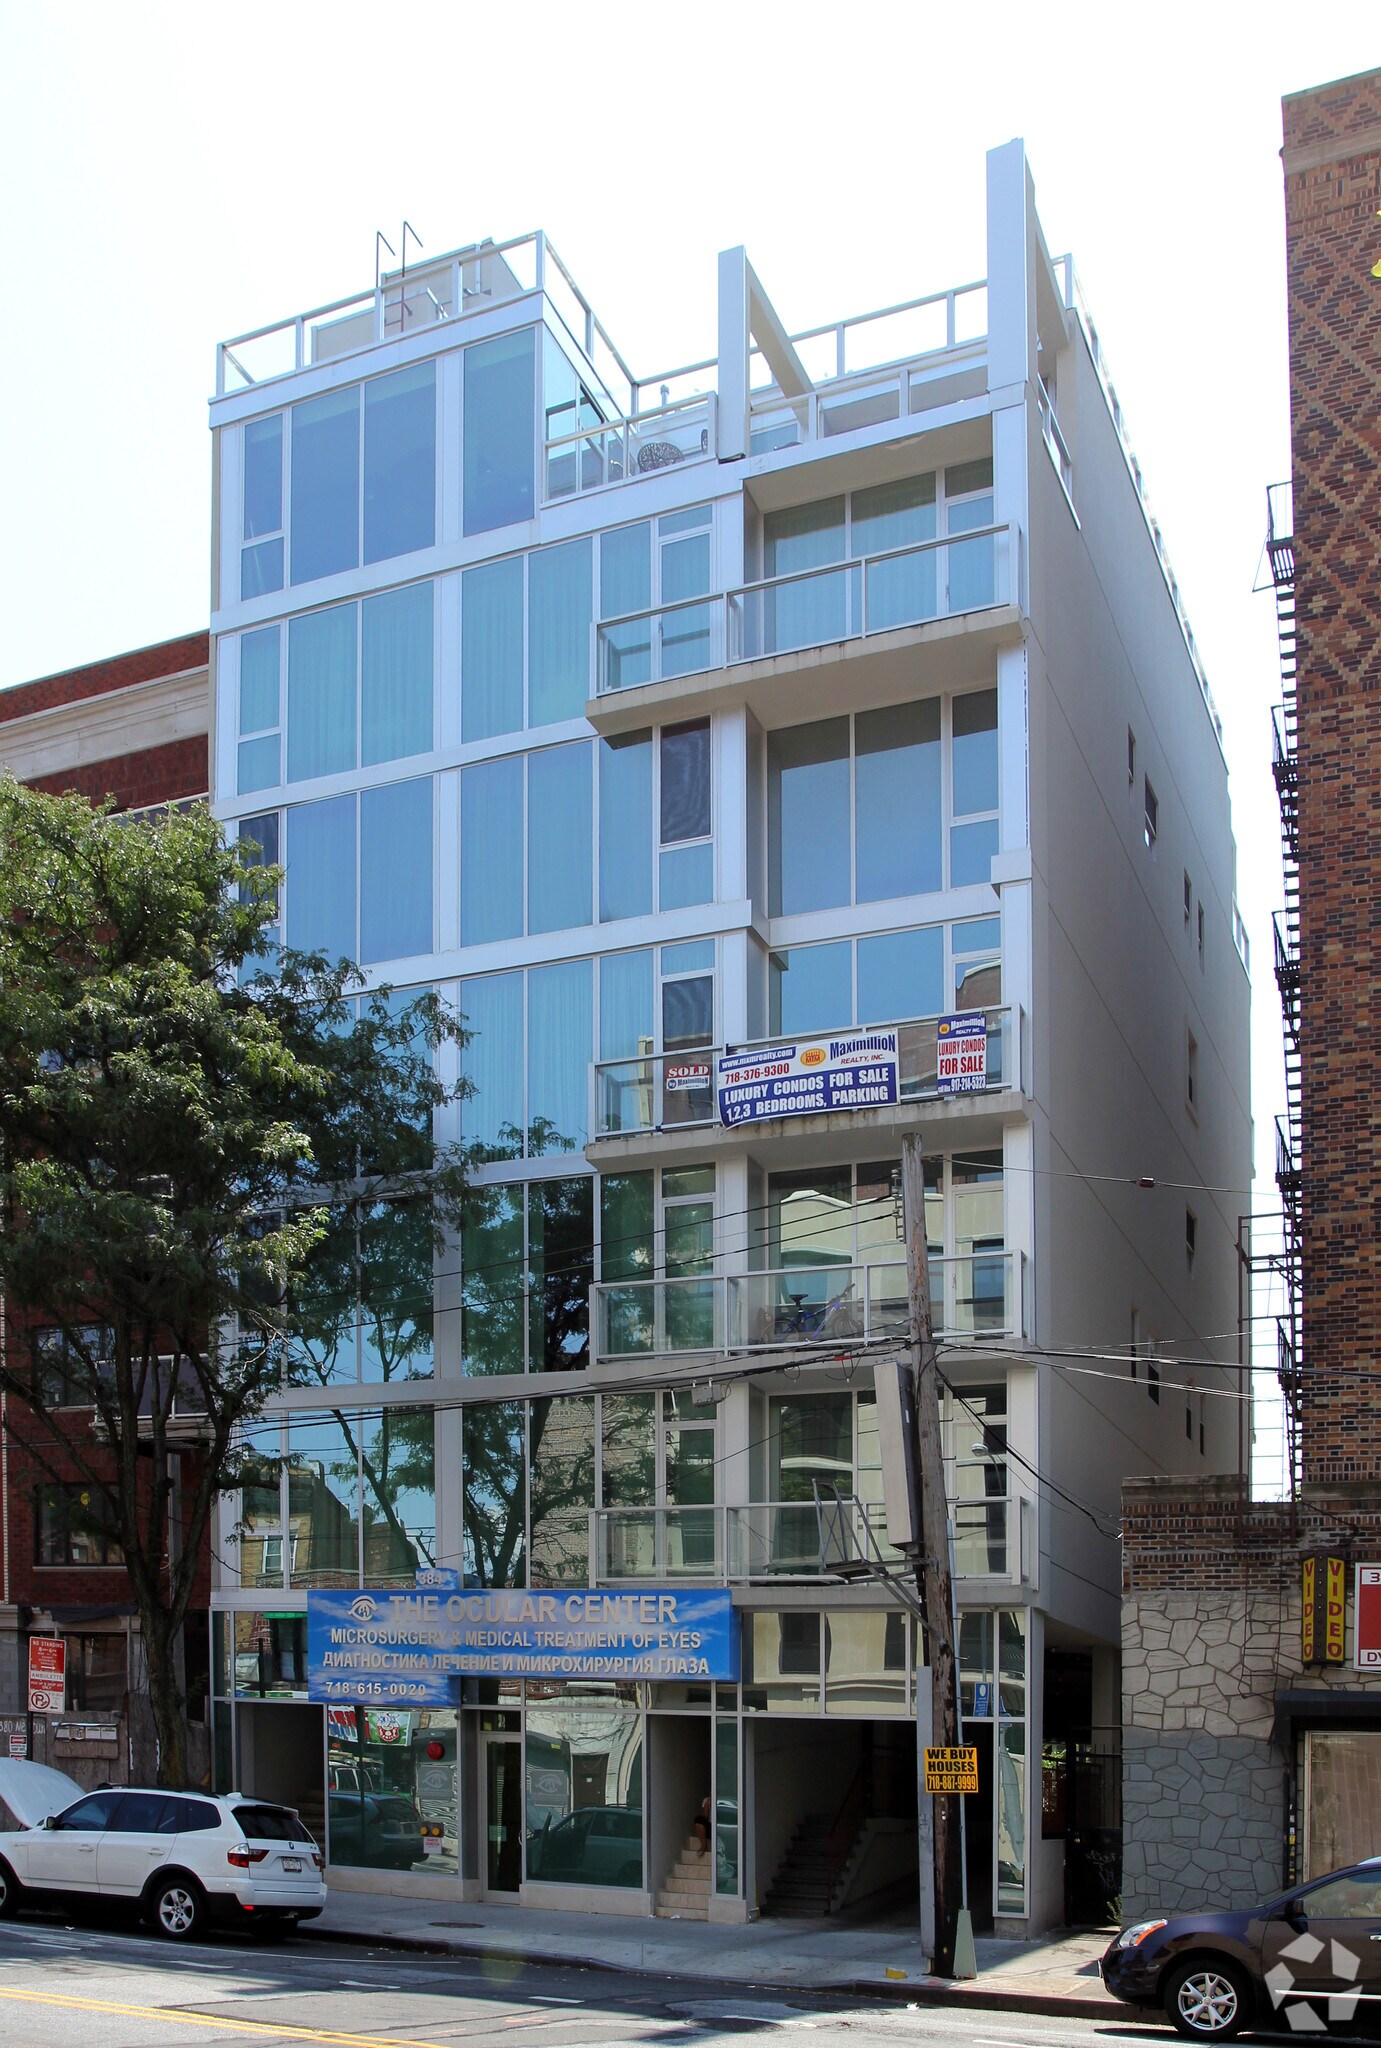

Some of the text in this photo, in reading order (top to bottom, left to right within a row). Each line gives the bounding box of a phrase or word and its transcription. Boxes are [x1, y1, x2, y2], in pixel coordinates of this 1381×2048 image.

[830, 1034, 896, 1060] MaximillioN
[939, 1038, 985, 1055] LUXURY CONDOS
[841, 1056, 869, 1064] REALTY,
[940, 1055, 983, 1075] FOR SALE
[668, 1066, 708, 1077] SOLD
[725, 1063, 790, 1084] 718-376-9300
[725, 1068, 889, 1105] LUXURY CONDOS FOR SALE
[726, 1086, 888, 1122] 1,2,3 BEDROOMS, PARKING
[419, 1573, 442, 1585] 384
[390, 1595, 678, 1624] THE OCULAR CENTER
[1304, 1561, 1313, 1658] VIDEO
[1328, 1561, 1342, 1658] VIDEO
[331, 1628, 701, 1648] MICROSURGERY & MEDICAL TREATMENT OF EYES
[323, 1652, 710, 1674] ДИАГНОСТИКА ЛЕЧЕНИЕ И МИКРОХИРУРГИЯ ГЛАЗА
[326, 1682, 426, 1696] 718-615-0020
[927, 1749, 974, 1760] WE BUY
[928, 1762, 974, 1772] HOUSES
[928, 1776, 976, 1790] 718-887-9999
